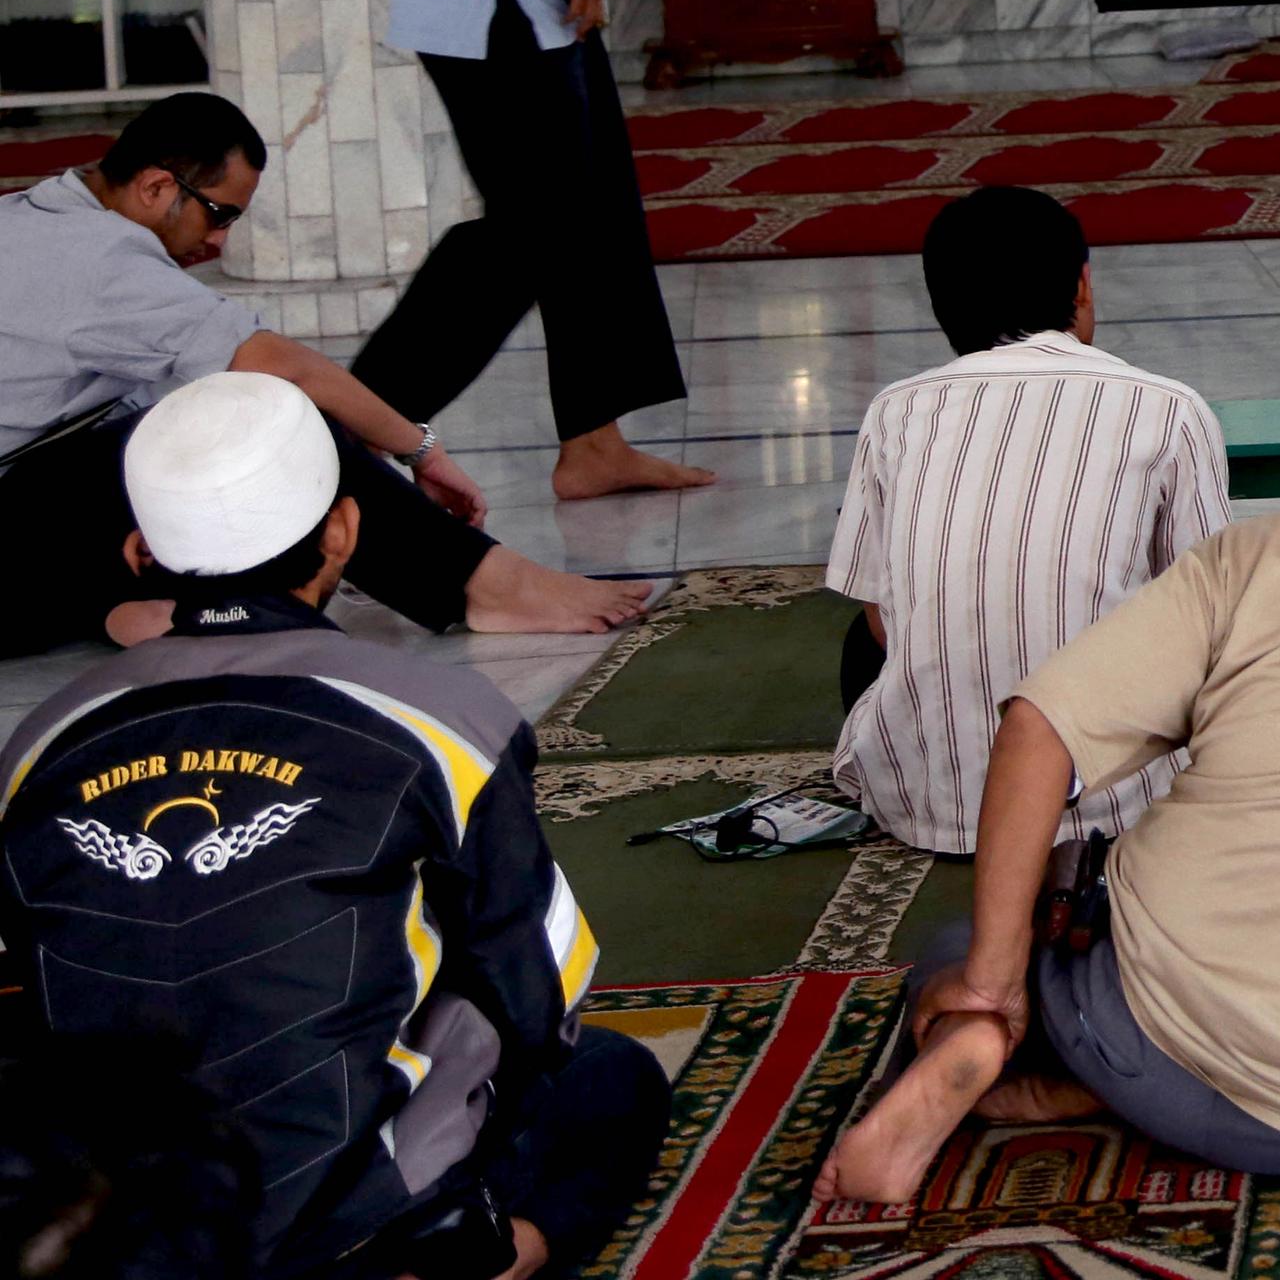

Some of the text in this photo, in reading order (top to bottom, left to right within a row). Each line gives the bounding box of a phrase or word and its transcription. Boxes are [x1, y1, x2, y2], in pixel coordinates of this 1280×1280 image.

[200, 606, 250, 624] Muslih
[80, 749, 303, 803] RIDER DAKWAH
